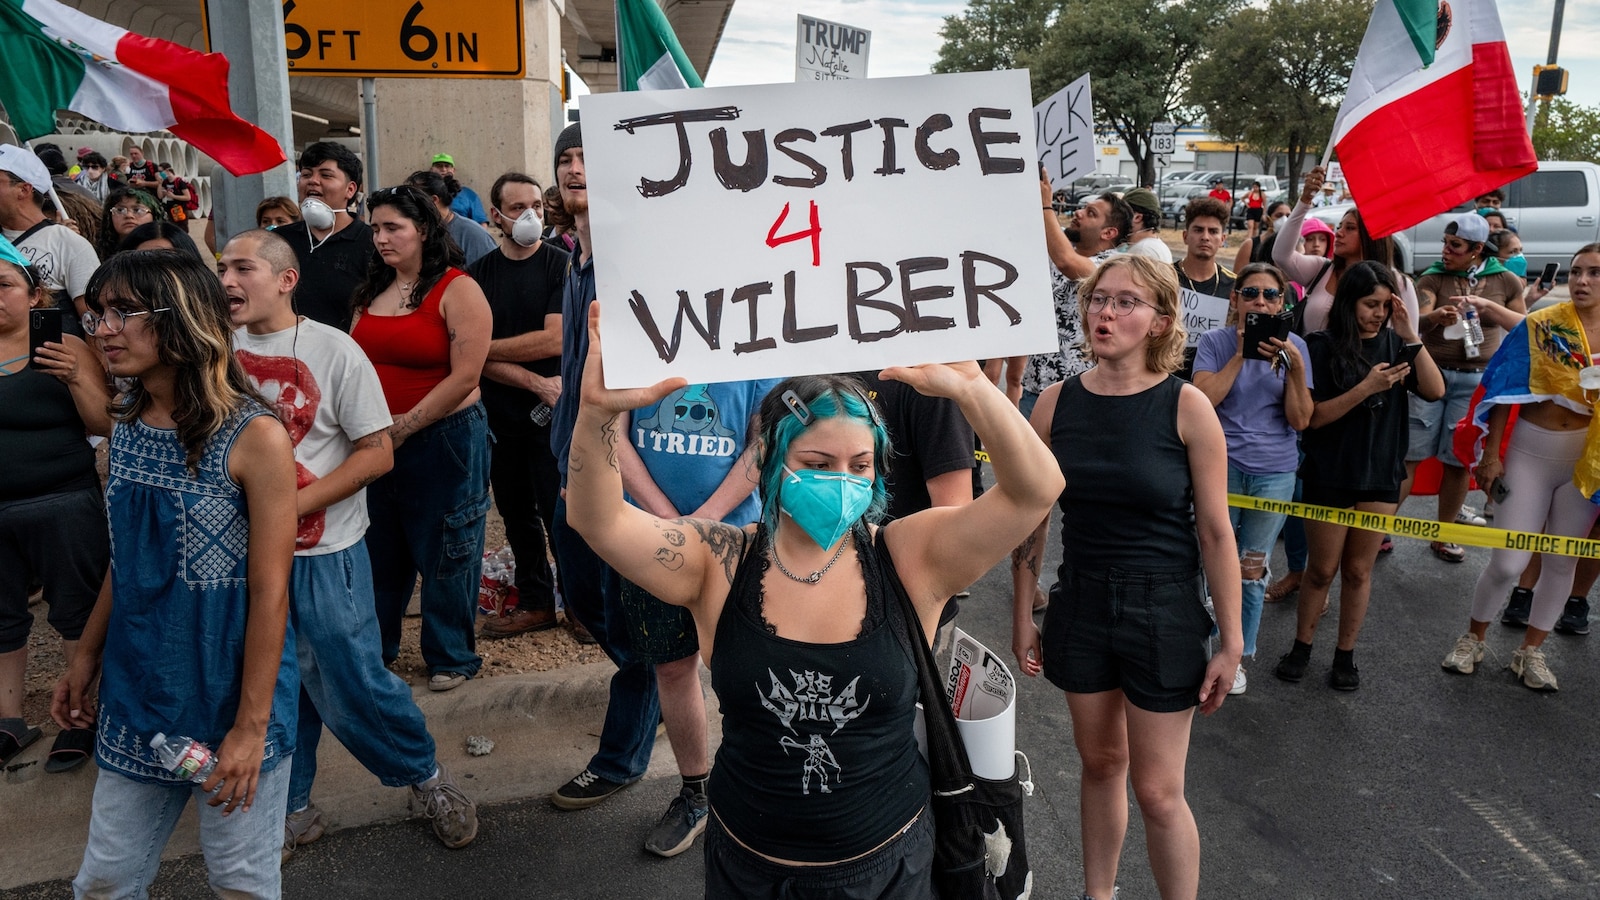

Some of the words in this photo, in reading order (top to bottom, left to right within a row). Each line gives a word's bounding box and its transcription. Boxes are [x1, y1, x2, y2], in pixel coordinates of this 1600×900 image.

[317, 30, 361, 60] FT
[400, 1, 438, 61] 6
[445, 32, 478, 62] IN
[802, 18, 867, 55] TRUMP
[806, 45, 839, 75] Natalie
[614, 106, 1026, 198] JUSTICE
[1155, 138, 1172, 150] 183
[766, 200, 822, 266] 4
[628, 250, 1022, 364] WILBER
[1180, 290, 1199, 310] NO
[637, 428, 646, 448] I
[650, 430, 736, 457] TRIED
